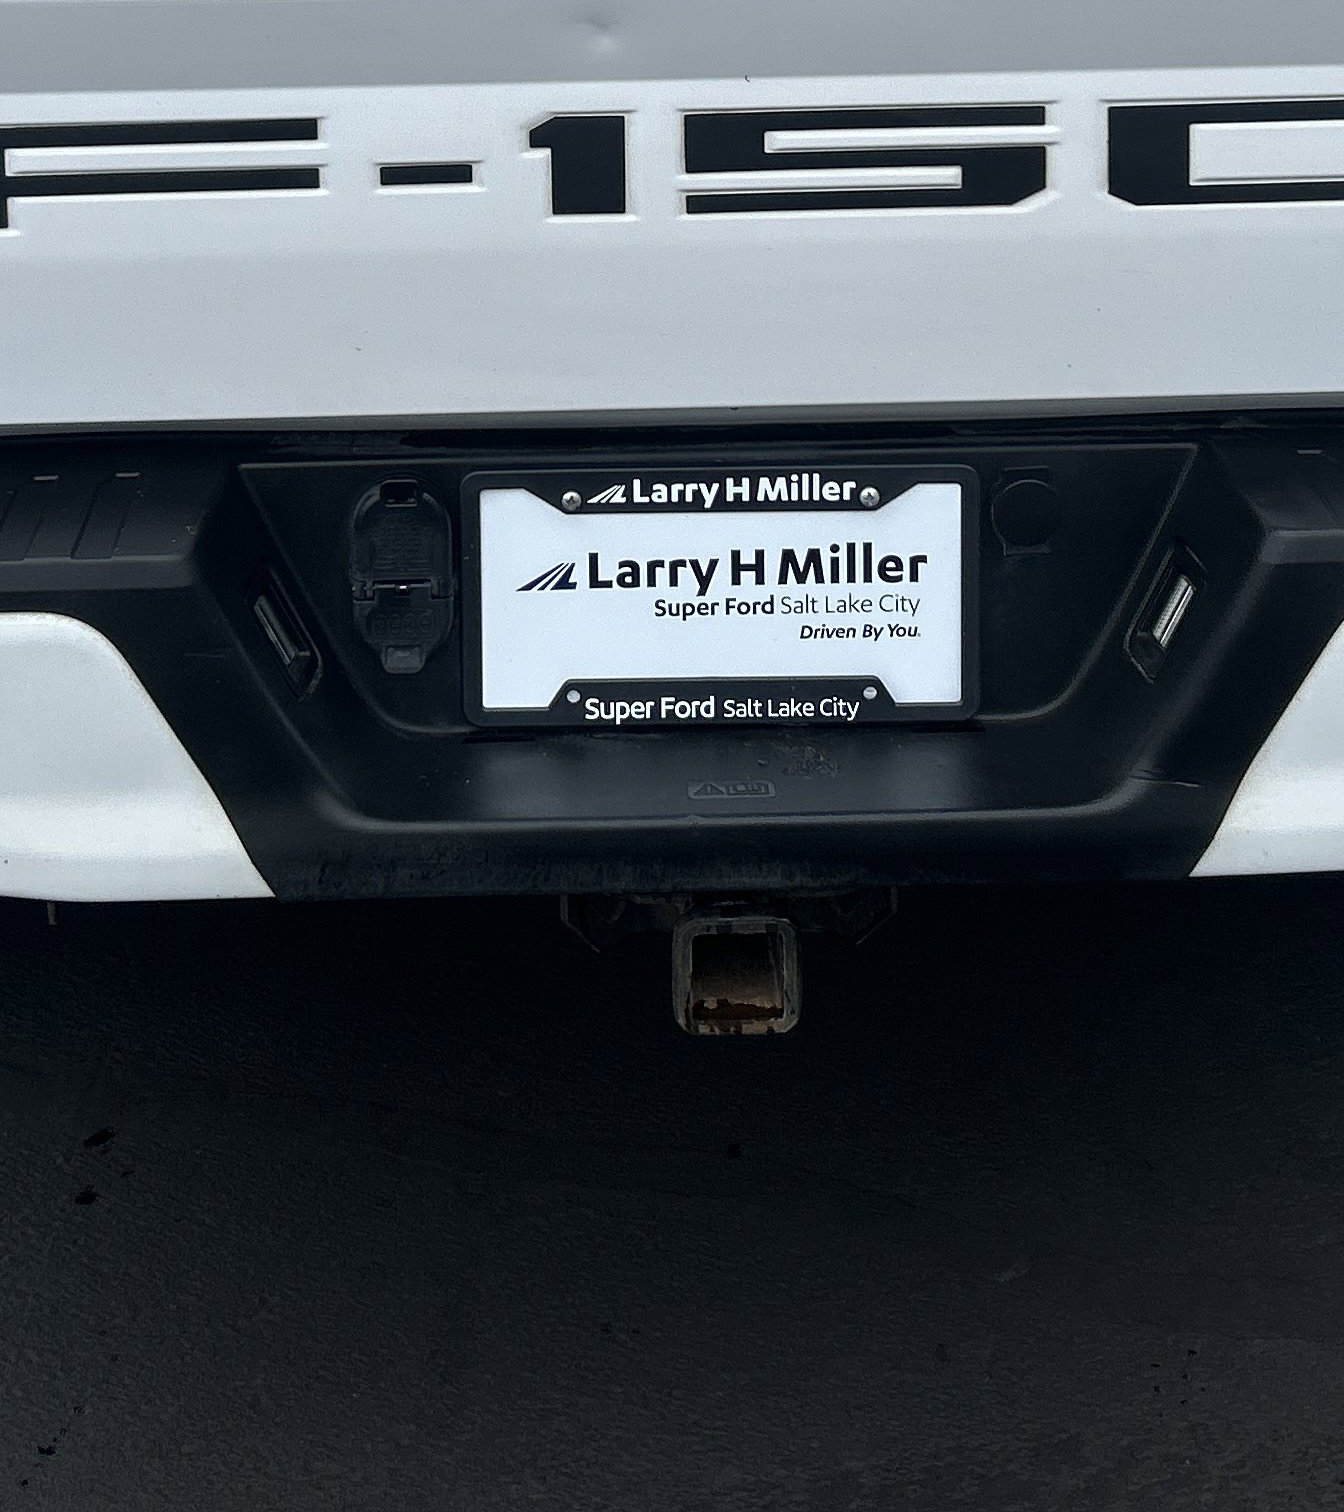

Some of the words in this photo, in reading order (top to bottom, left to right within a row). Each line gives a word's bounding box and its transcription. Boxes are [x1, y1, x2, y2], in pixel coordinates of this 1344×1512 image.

[632, 478, 720, 509] Larry
[725, 477, 750, 502] H
[756, 472, 857, 502] Miller
[588, 552, 720, 597] Larry
[730, 548, 766, 586] H
[777, 541, 928, 585] Miller
[654, 598, 720, 622] Super
[725, 594, 775, 616] Ford
[780, 594, 819, 615] Salt
[825, 592, 873, 614] Lake
[878, 593, 921, 618] City
[799, 623, 857, 640] Driven
[862, 623, 884, 642] By
[584, 697, 655, 726] Super
[660, 695, 715, 719] Ford
[723, 698, 763, 718] Salt
[767, 697, 815, 718] Lake
[819, 696, 860, 720] City
